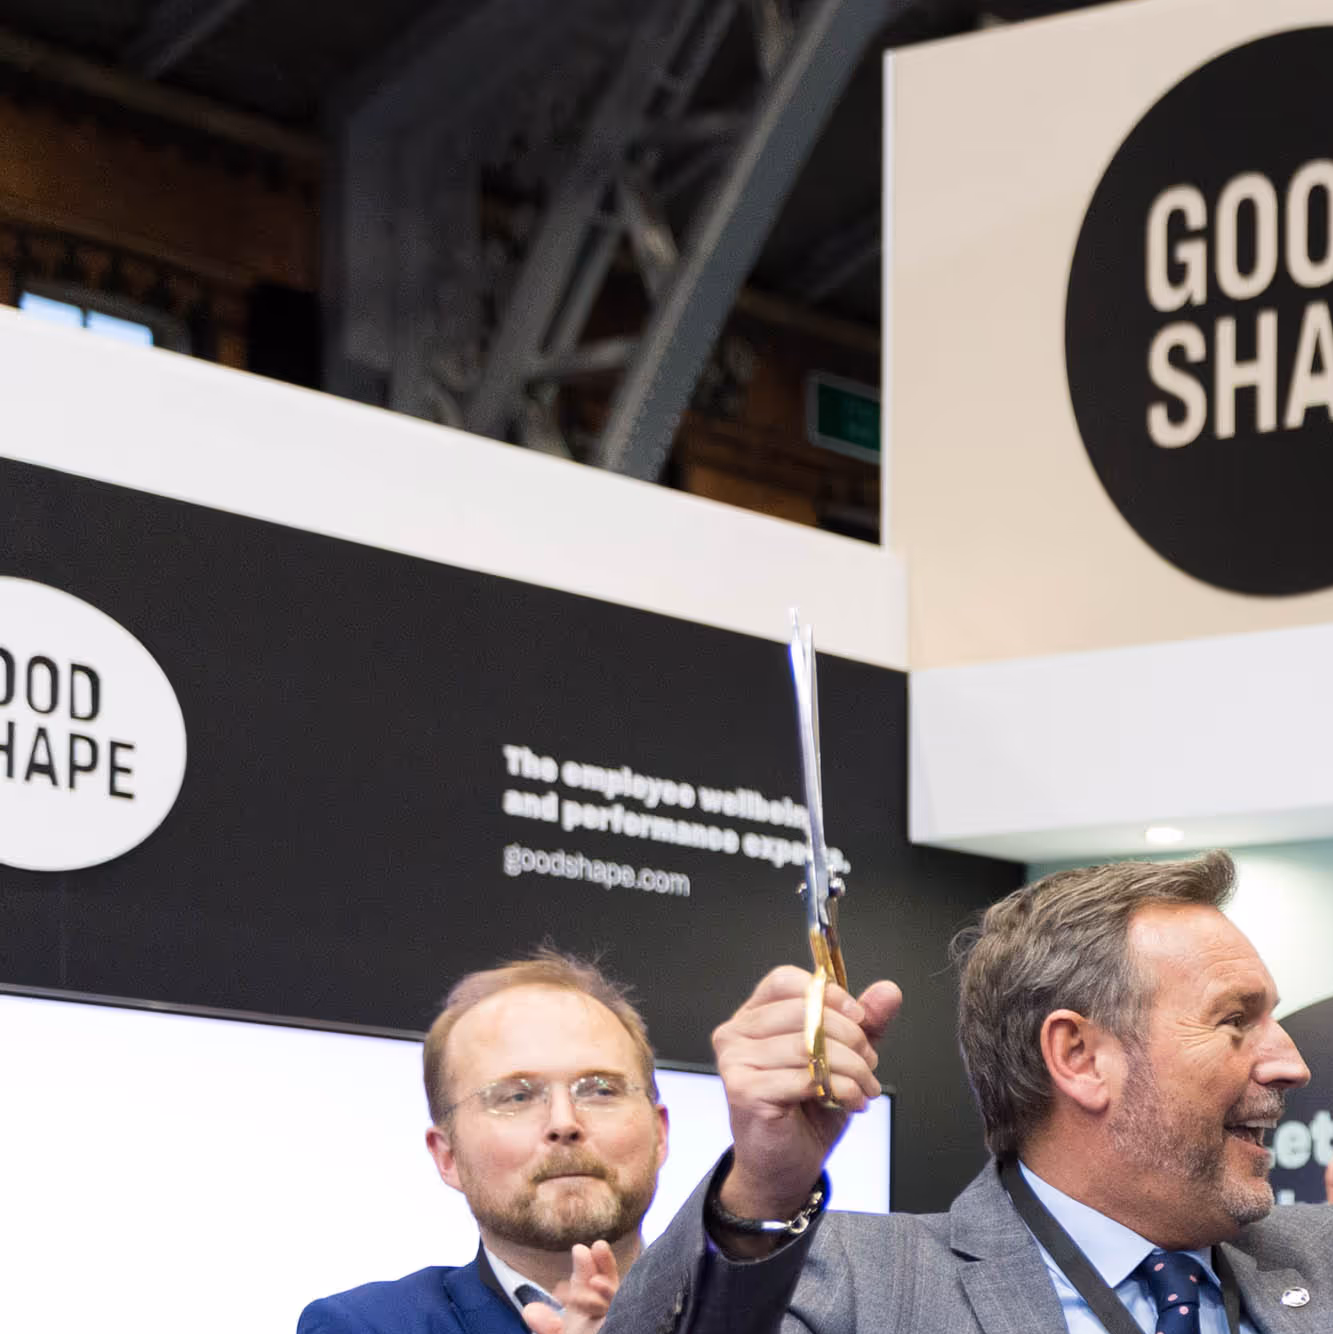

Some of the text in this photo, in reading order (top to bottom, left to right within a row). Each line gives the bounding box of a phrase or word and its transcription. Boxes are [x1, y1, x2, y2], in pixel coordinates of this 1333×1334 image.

[0, 646, 101, 721] OD
[0, 721, 136, 800] APE
[503, 744, 810, 829] The employee wellbein
[503, 789, 559, 822] and
[561, 799, 740, 854] performance
[503, 843, 691, 897] goodshape.com
